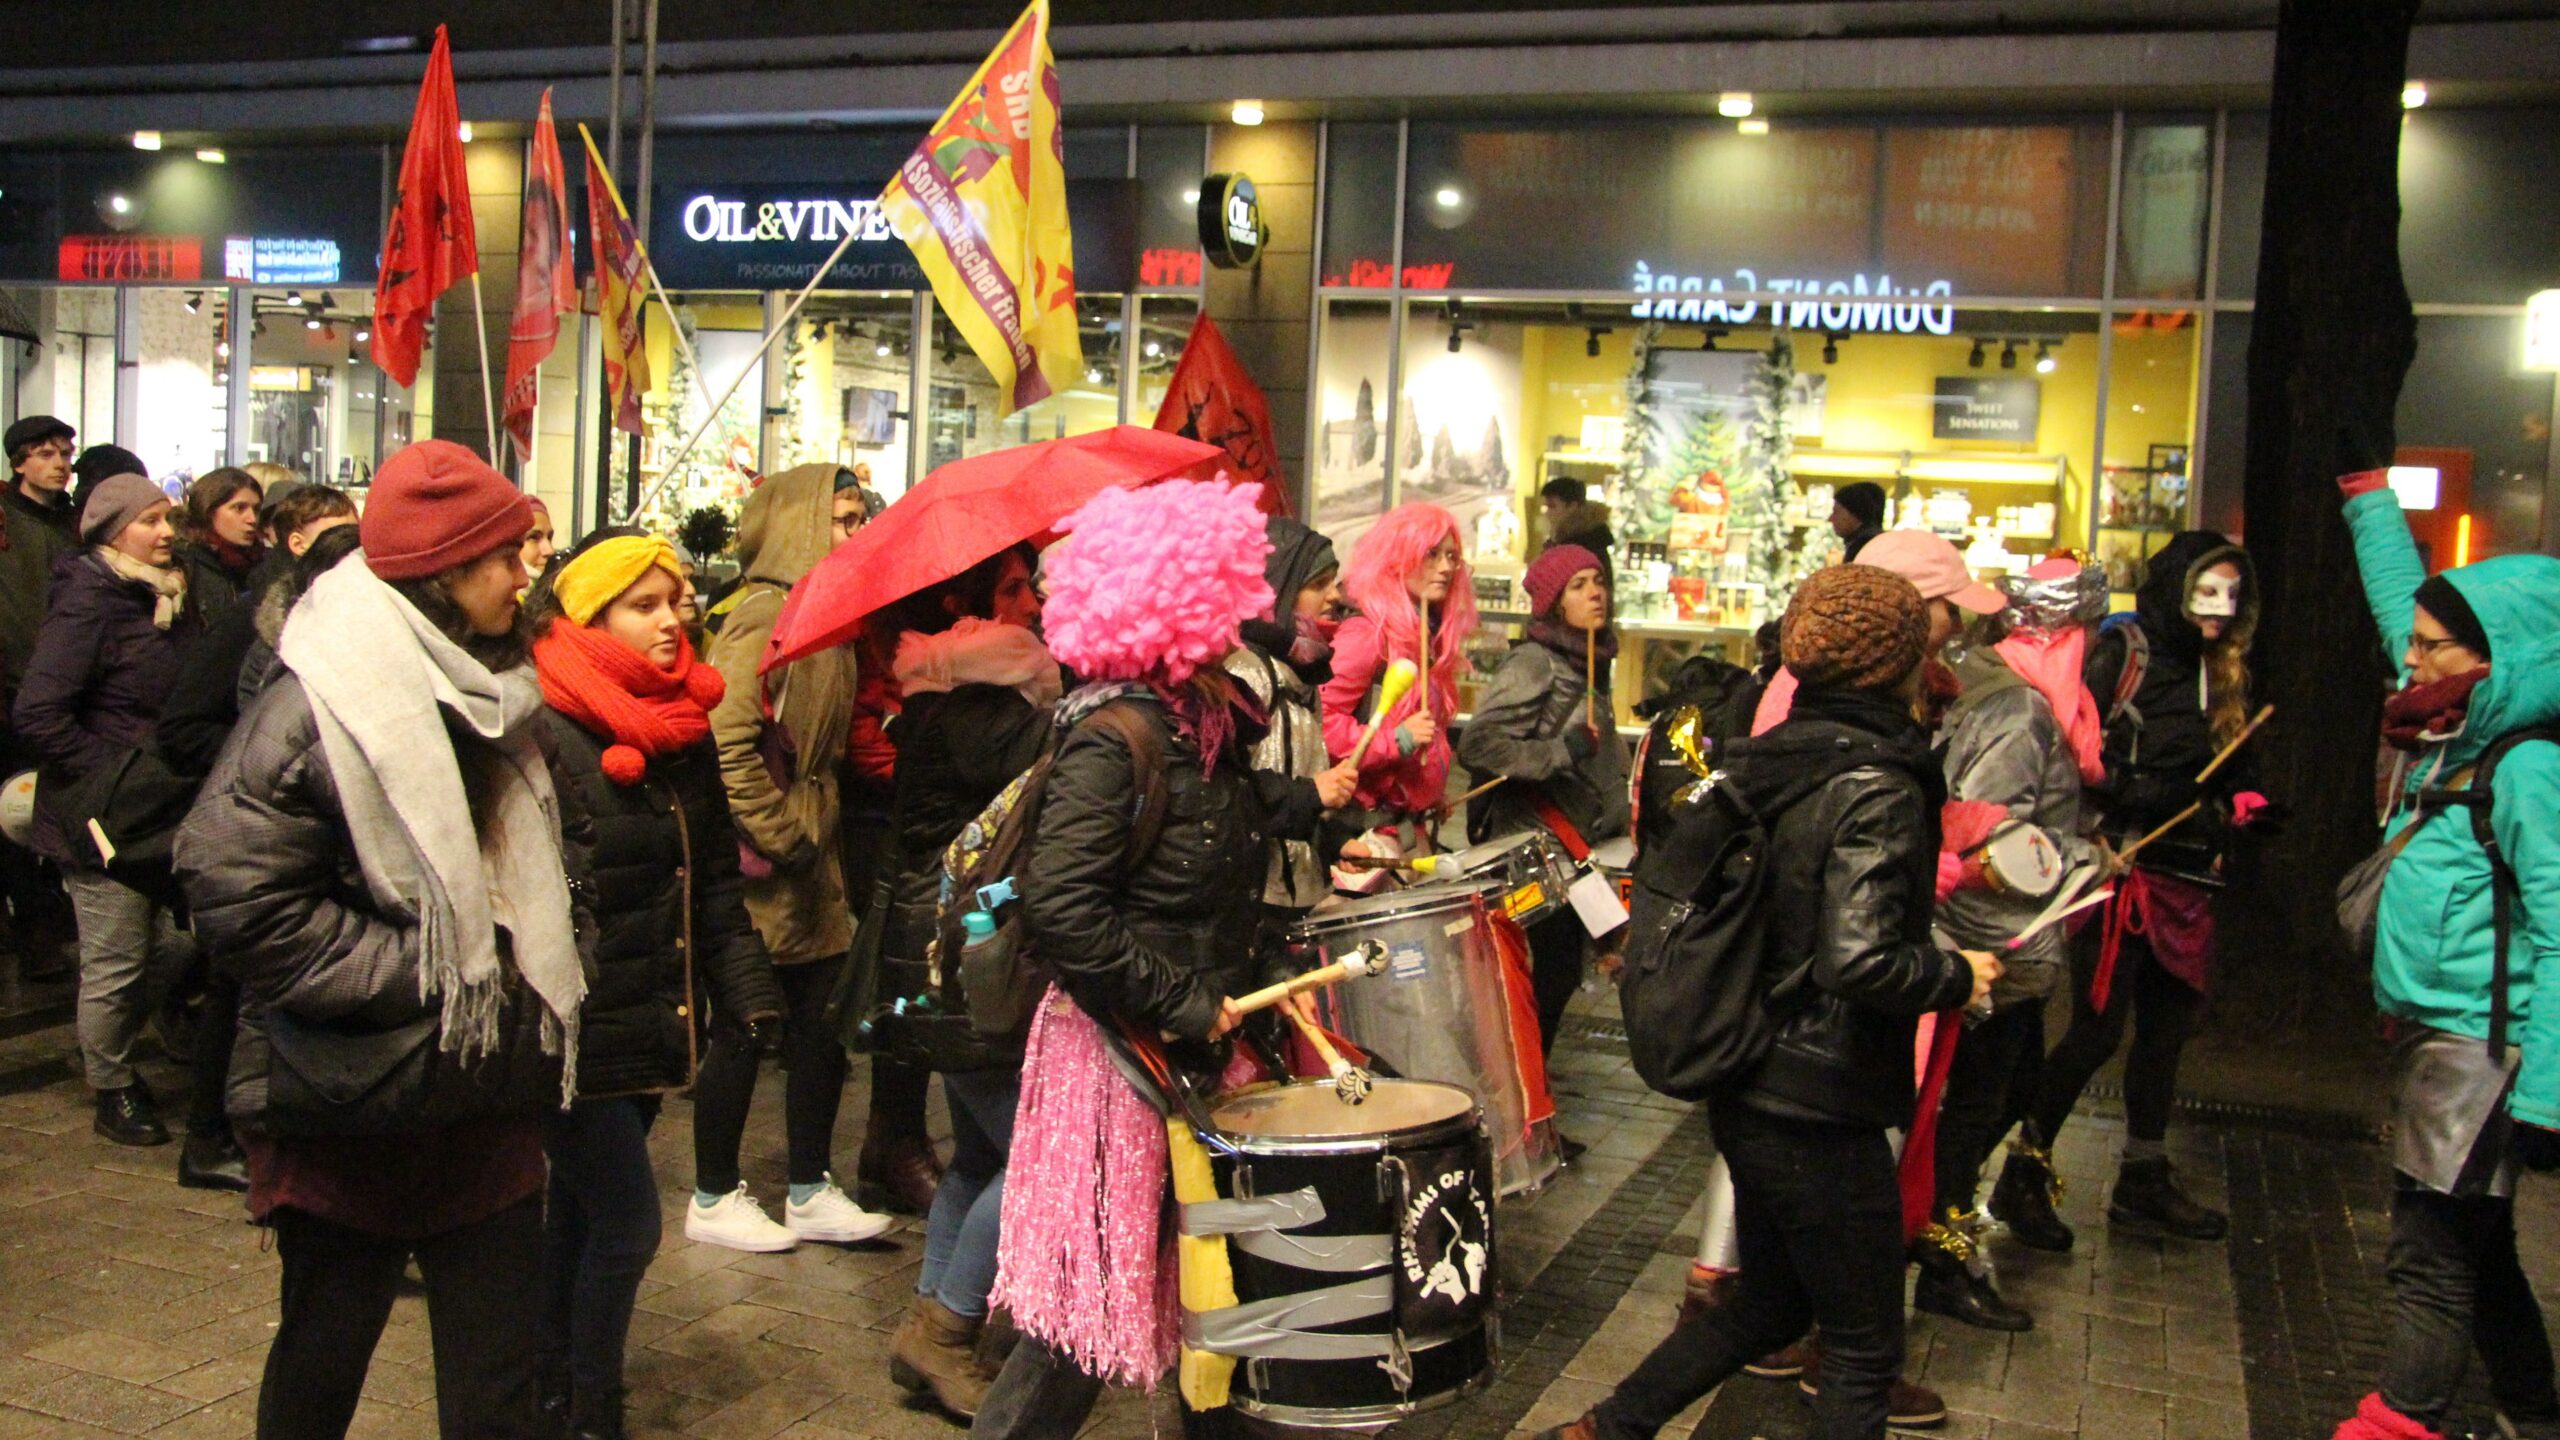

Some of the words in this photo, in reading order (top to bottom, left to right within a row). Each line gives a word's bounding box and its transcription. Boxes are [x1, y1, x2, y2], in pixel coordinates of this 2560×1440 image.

[907, 161, 1004, 300] Sozialistischer
[991, 292, 1032, 371] Frauen
[1439, 1169, 1465, 1189] OF
